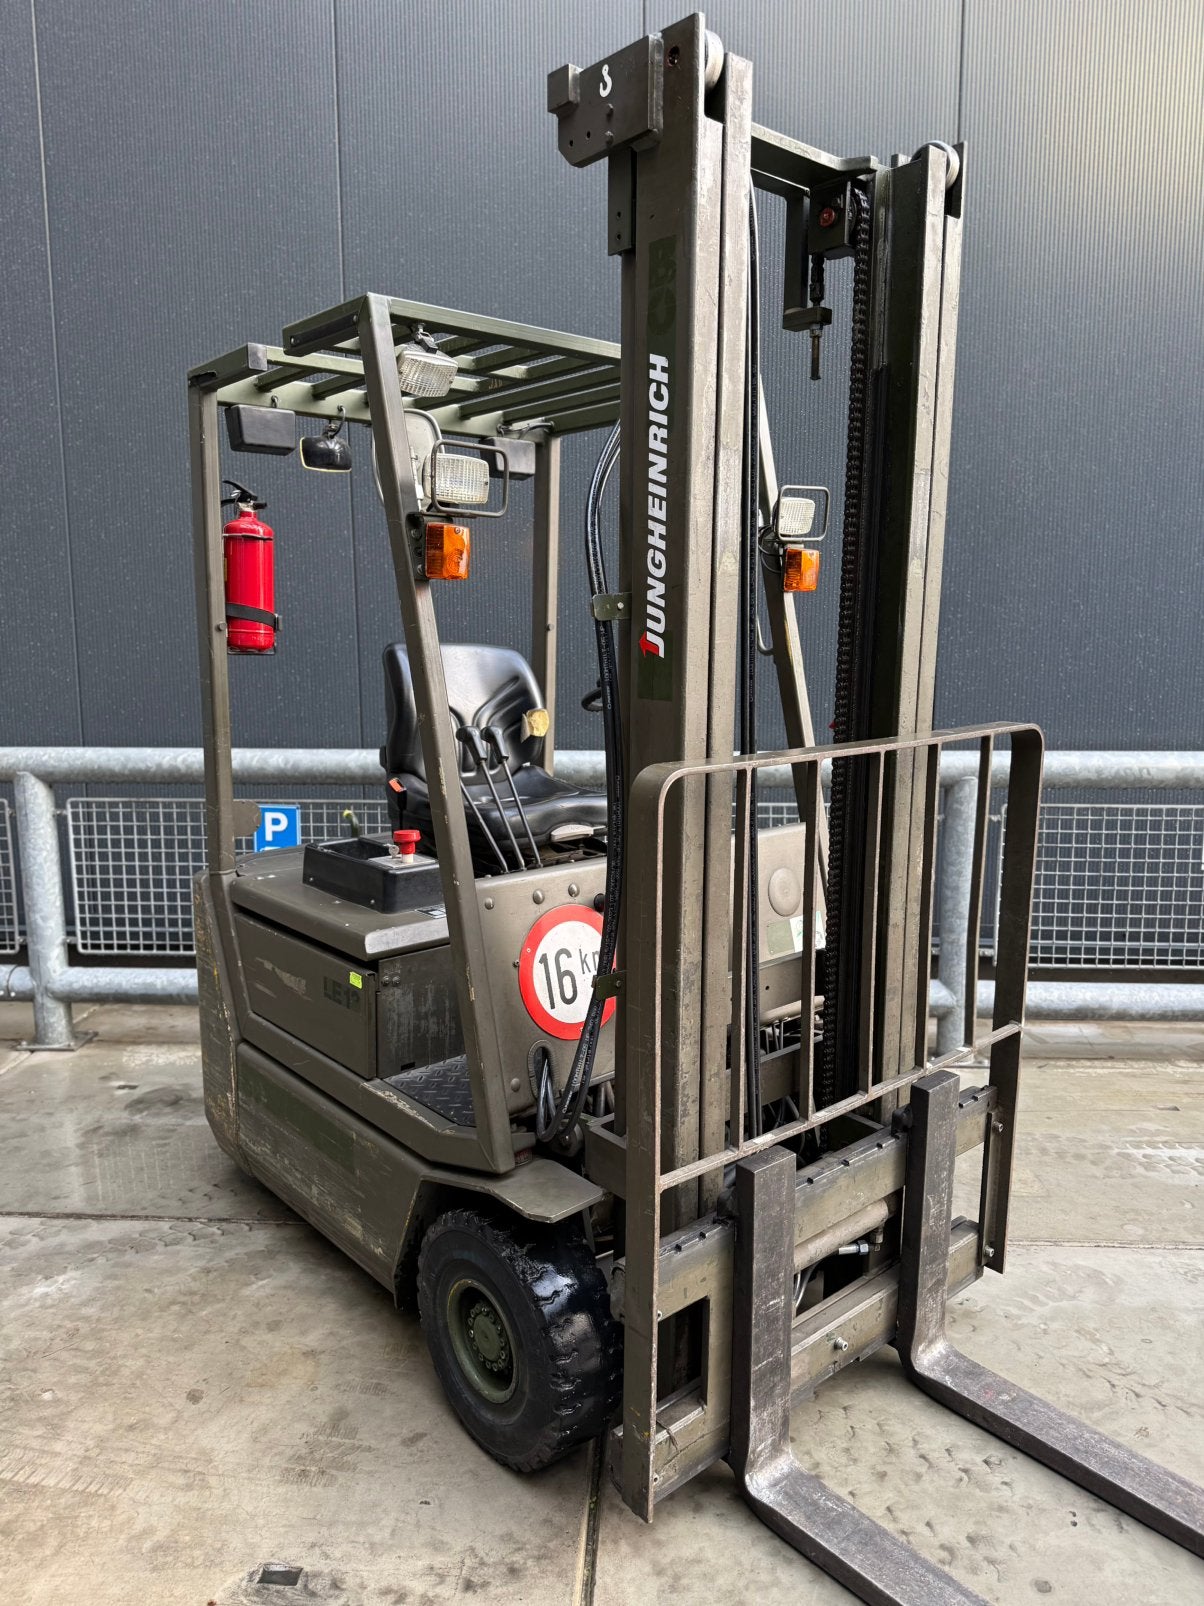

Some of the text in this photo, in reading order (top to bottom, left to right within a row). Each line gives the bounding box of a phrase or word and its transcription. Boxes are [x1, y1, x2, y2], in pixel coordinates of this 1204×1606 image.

[645, 353, 669, 658] JUNGHEINRICH
[264, 811, 289, 842] P
[539, 947, 578, 1010] 16
